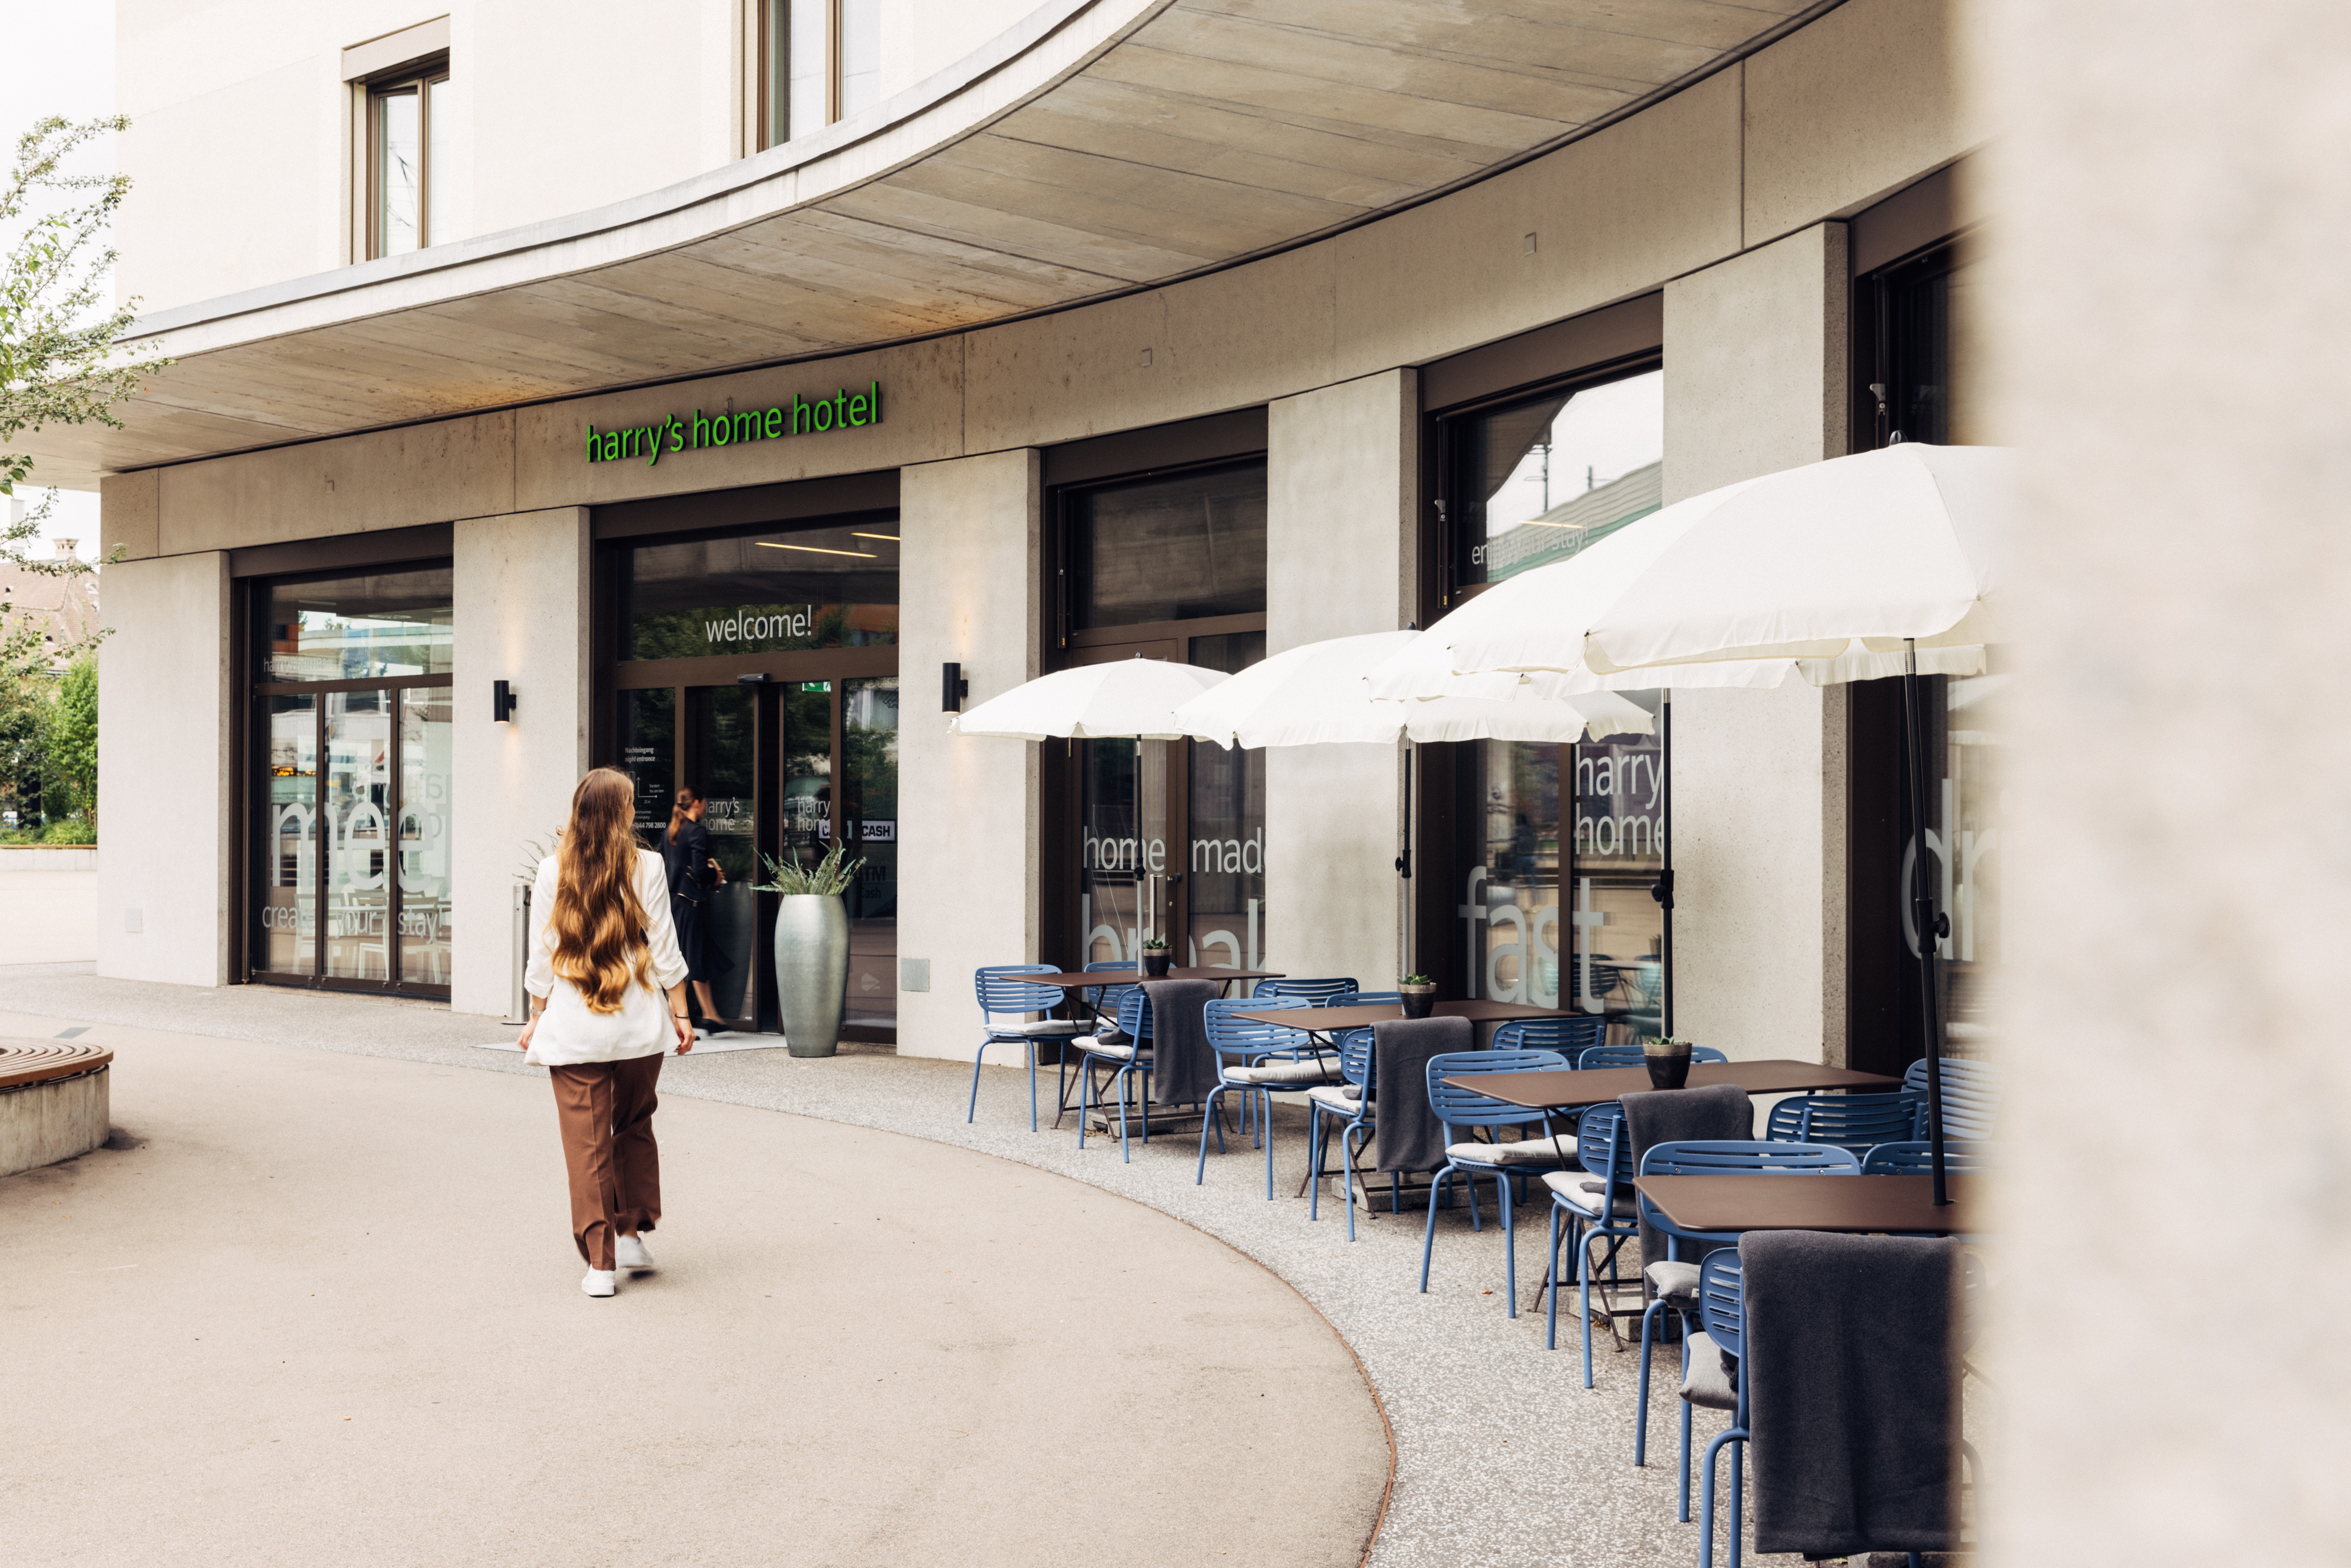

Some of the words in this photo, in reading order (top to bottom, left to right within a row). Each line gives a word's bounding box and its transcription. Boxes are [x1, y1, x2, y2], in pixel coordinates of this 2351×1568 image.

[587, 414, 684, 465] harry's
[693, 409, 782, 448] home
[793, 381, 880, 434] hotel
[706, 605, 812, 642] welcome!
[705, 796, 739, 817] arry's
[862, 825, 890, 837] CASH
[1084, 826, 1166, 871] home
[1193, 827, 1265, 873] mad
[334, 910, 377, 939] your
[397, 905, 443, 944] stay!
[1458, 866, 1604, 1014] fast
